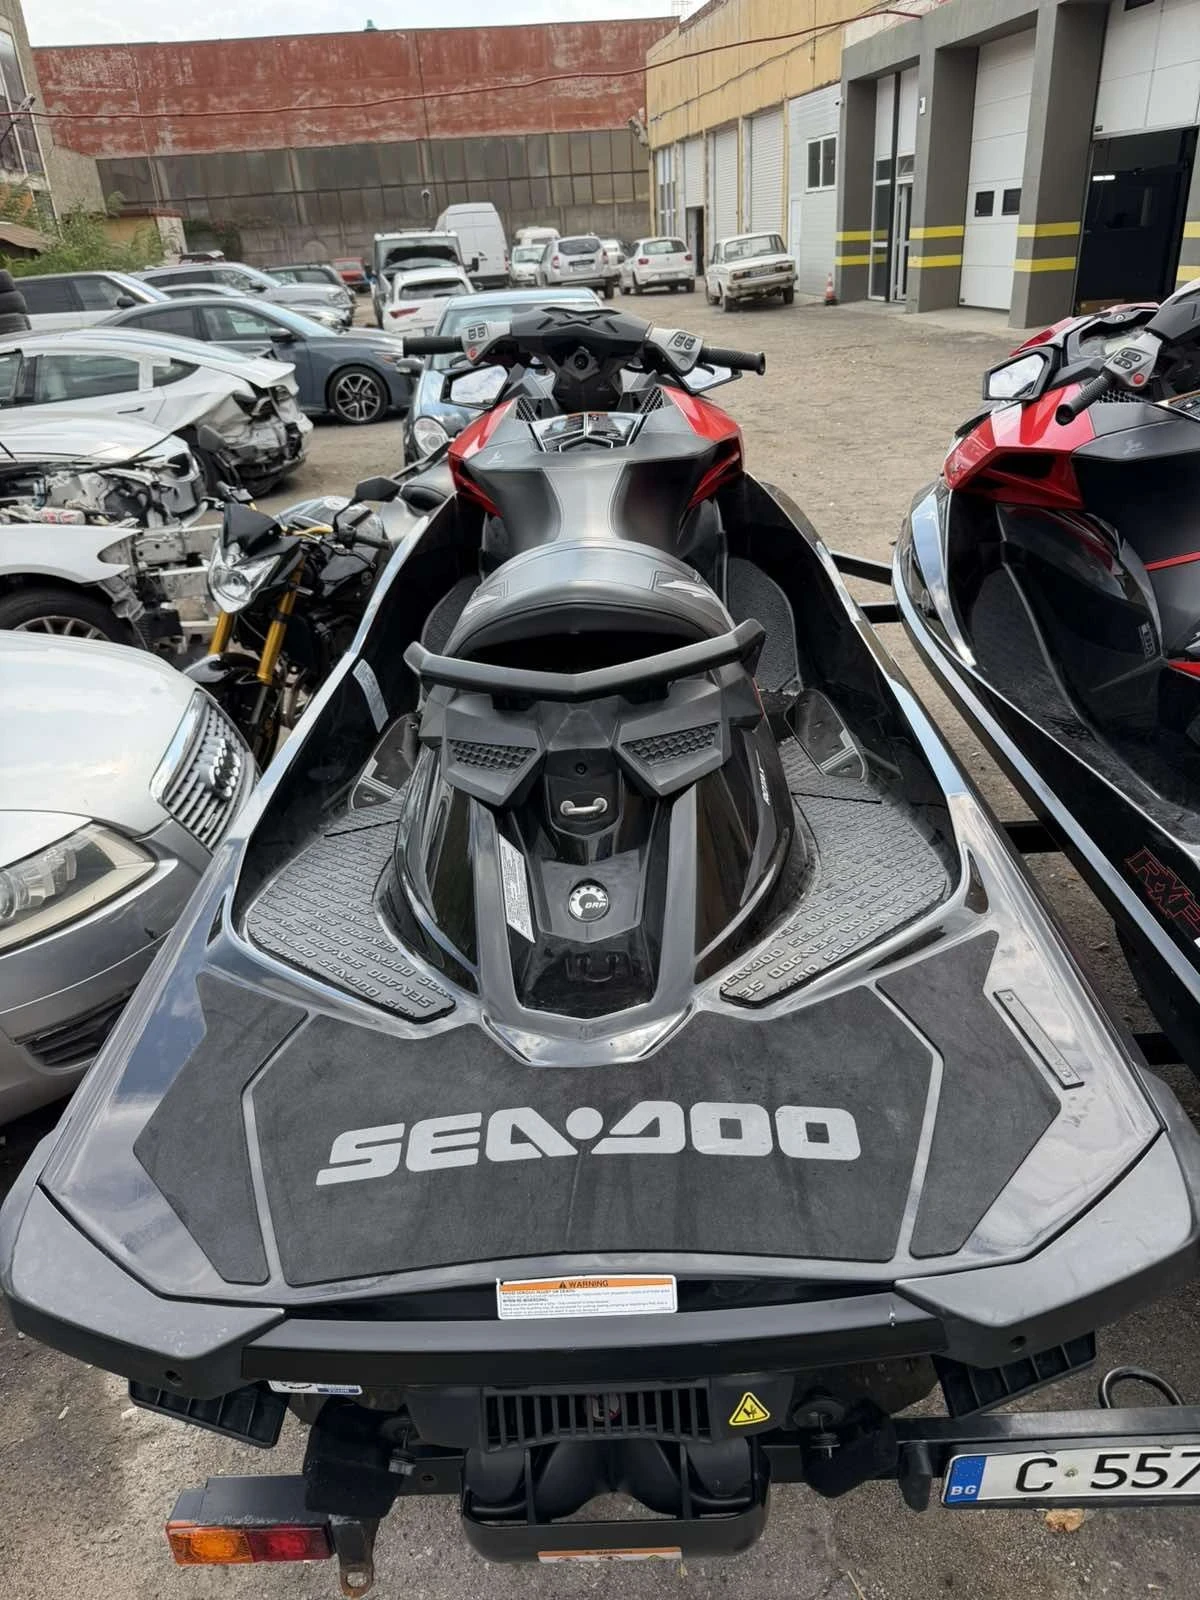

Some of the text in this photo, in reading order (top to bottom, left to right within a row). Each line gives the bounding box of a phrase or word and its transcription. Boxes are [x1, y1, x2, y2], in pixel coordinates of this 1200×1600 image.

[568, 1279, 609, 1289] WARNING
[951, 1452, 1200, 1496] BG C 557
